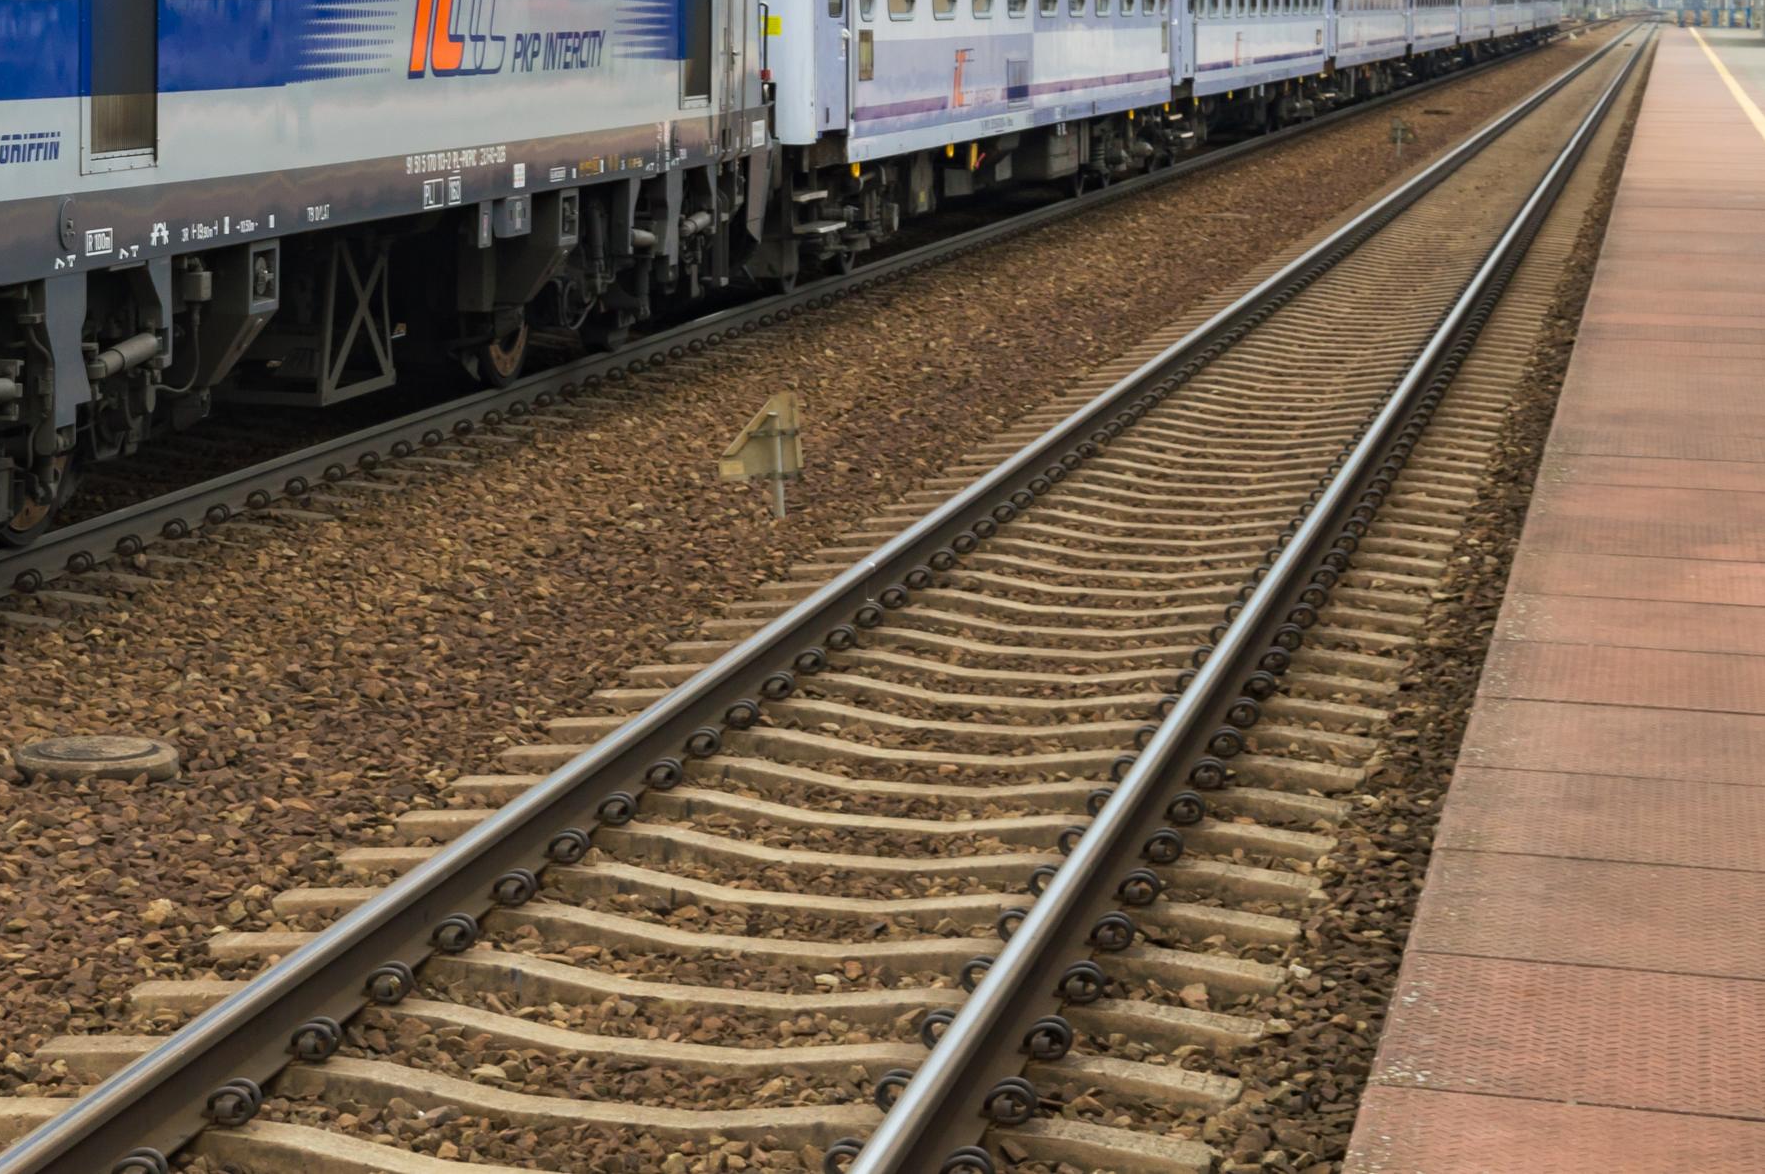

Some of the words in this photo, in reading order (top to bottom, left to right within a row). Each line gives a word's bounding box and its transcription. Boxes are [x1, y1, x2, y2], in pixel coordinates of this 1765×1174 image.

[511, 32, 541, 73] PKP
[542, 30, 606, 71] INTERCITY
[0, 131, 61, 164] GRIFFIN
